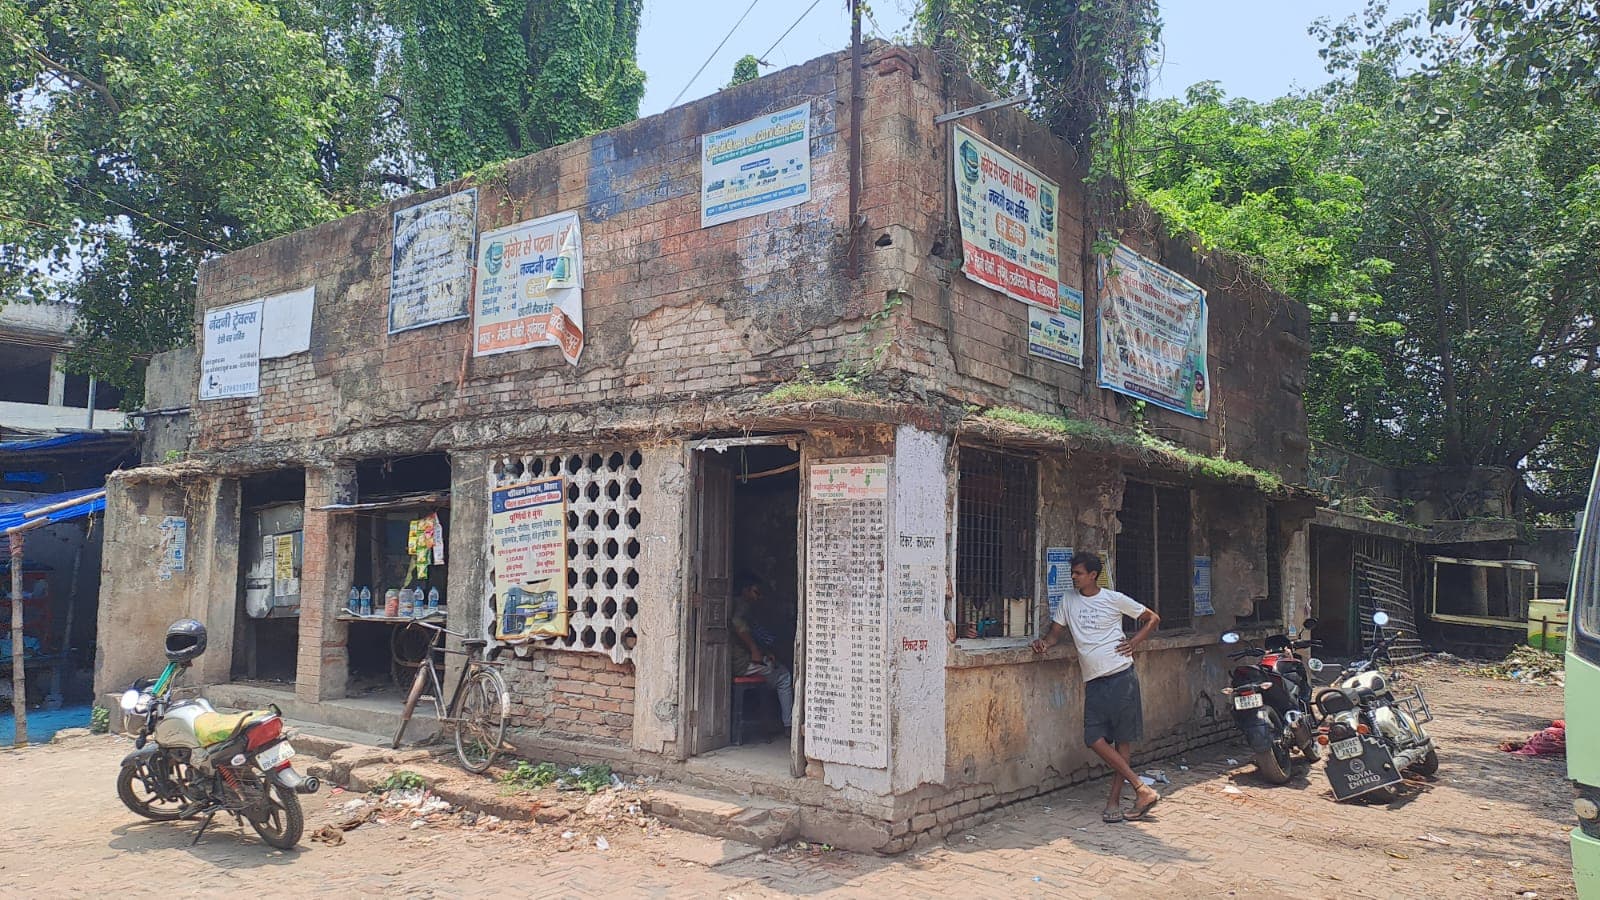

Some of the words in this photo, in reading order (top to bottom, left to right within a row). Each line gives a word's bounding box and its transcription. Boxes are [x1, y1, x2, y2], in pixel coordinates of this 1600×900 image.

[503, 236, 522, 268] मुंगेर
[523, 234, 532, 256] से
[534, 234, 555, 254] पटना
[209, 311, 231, 331] नंदनी
[232, 310, 257, 331] ट्रेवल्स
[903, 636, 918, 652] टिकट
[919, 640, 928, 651] घर
[1344, 769, 1375, 782] ROYAL
[1348, 774, 1381, 790] ENFIELD
